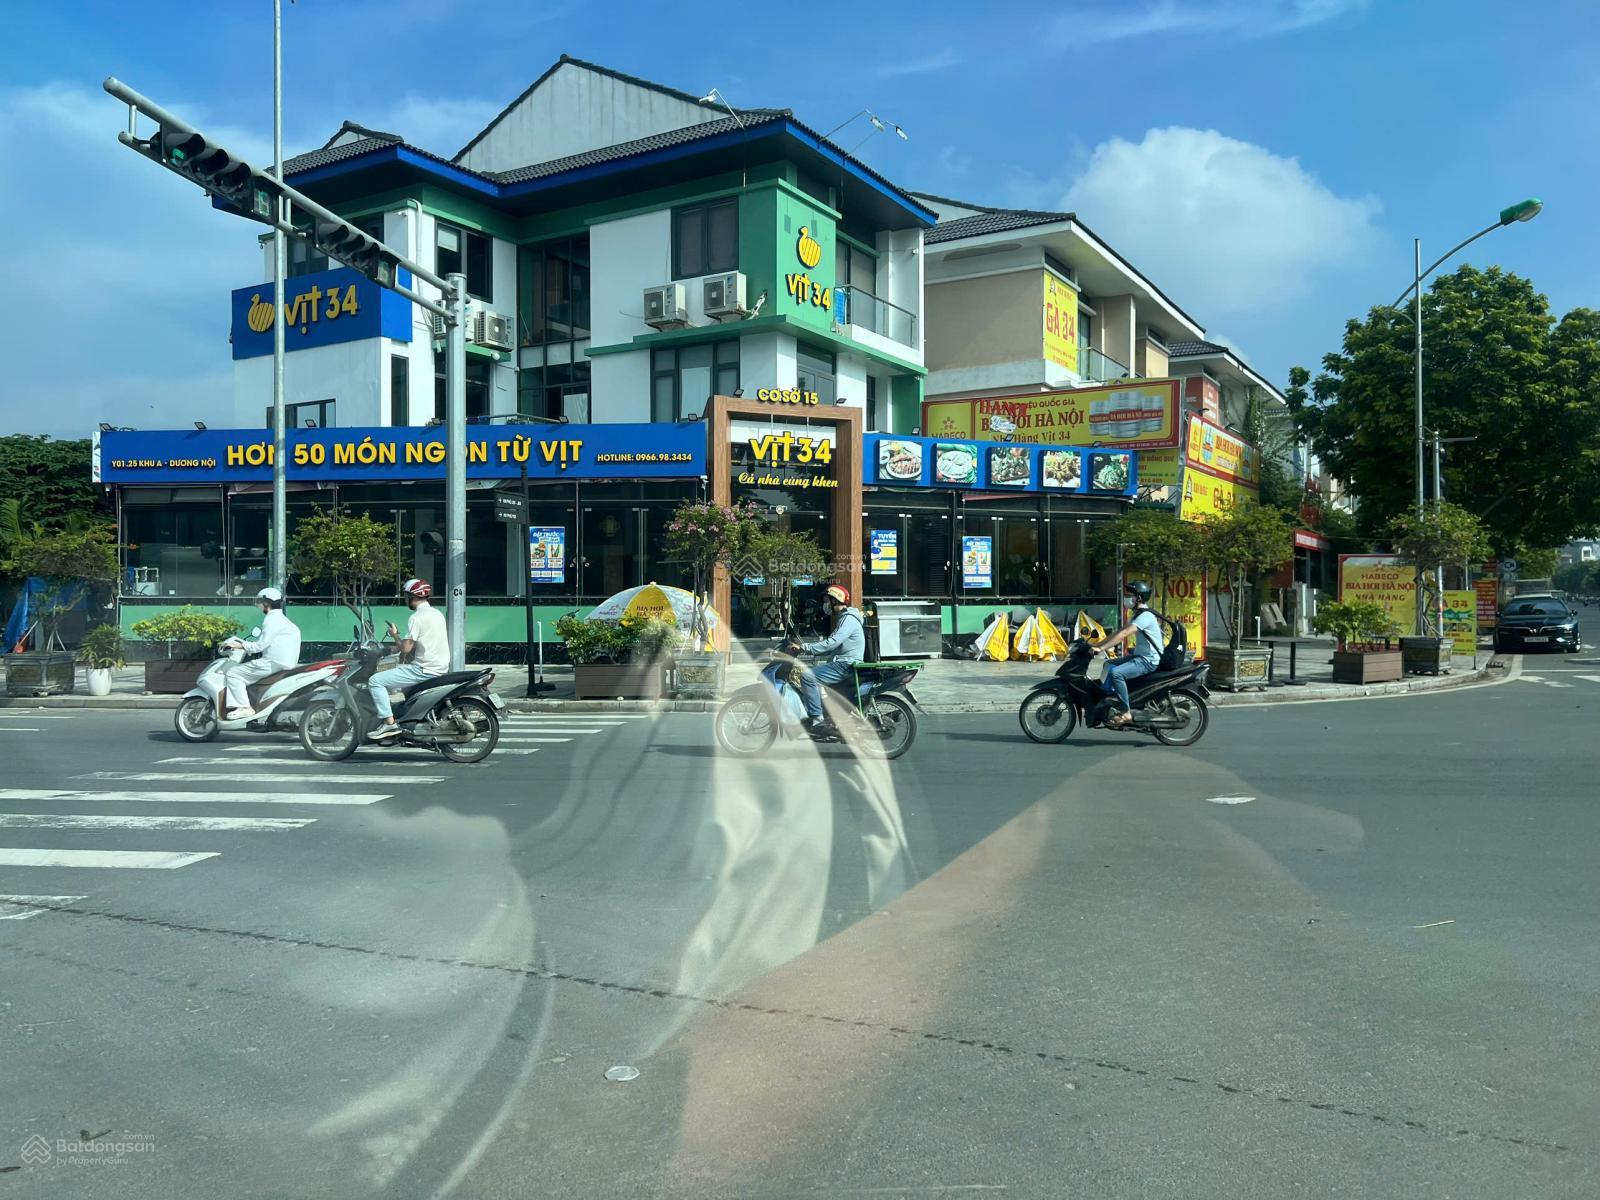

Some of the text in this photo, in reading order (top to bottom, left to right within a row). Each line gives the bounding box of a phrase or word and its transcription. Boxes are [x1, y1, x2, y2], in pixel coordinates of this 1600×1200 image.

[326, 284, 358, 319] 34
[812, 282, 831, 310] 34
[1062, 311, 1075, 344] 34
[803, 391, 819, 404] 15
[1040, 399, 1060, 409] QUỐC
[1063, 399, 1075, 407] GIA
[1035, 409, 1055, 428] HÀ
[1058, 407, 1085, 429] NỘI
[1042, 431, 1055, 445] Vịt
[1059, 430, 1071, 441] 34
[294, 443, 325, 465] 50
[334, 436, 396, 464] MÓN
[406, 441, 487, 463] NGN
[497, 434, 532, 462] TỪ
[540, 440, 583, 469] VỊT
[597, 453, 692, 462] HOTLINE: 0966.98.3434
[797, 437, 832, 464] 34
[138, 459, 155, 468] KHU
[156, 460, 163, 468] A
[201, 457, 216, 469] NỘI
[758, 474, 780, 486] nhà
[783, 475, 810, 487] cùng
[812, 475, 840, 488] khen
[453, 588, 463, 597] C4
[1345, 582, 1360, 590] BIA
